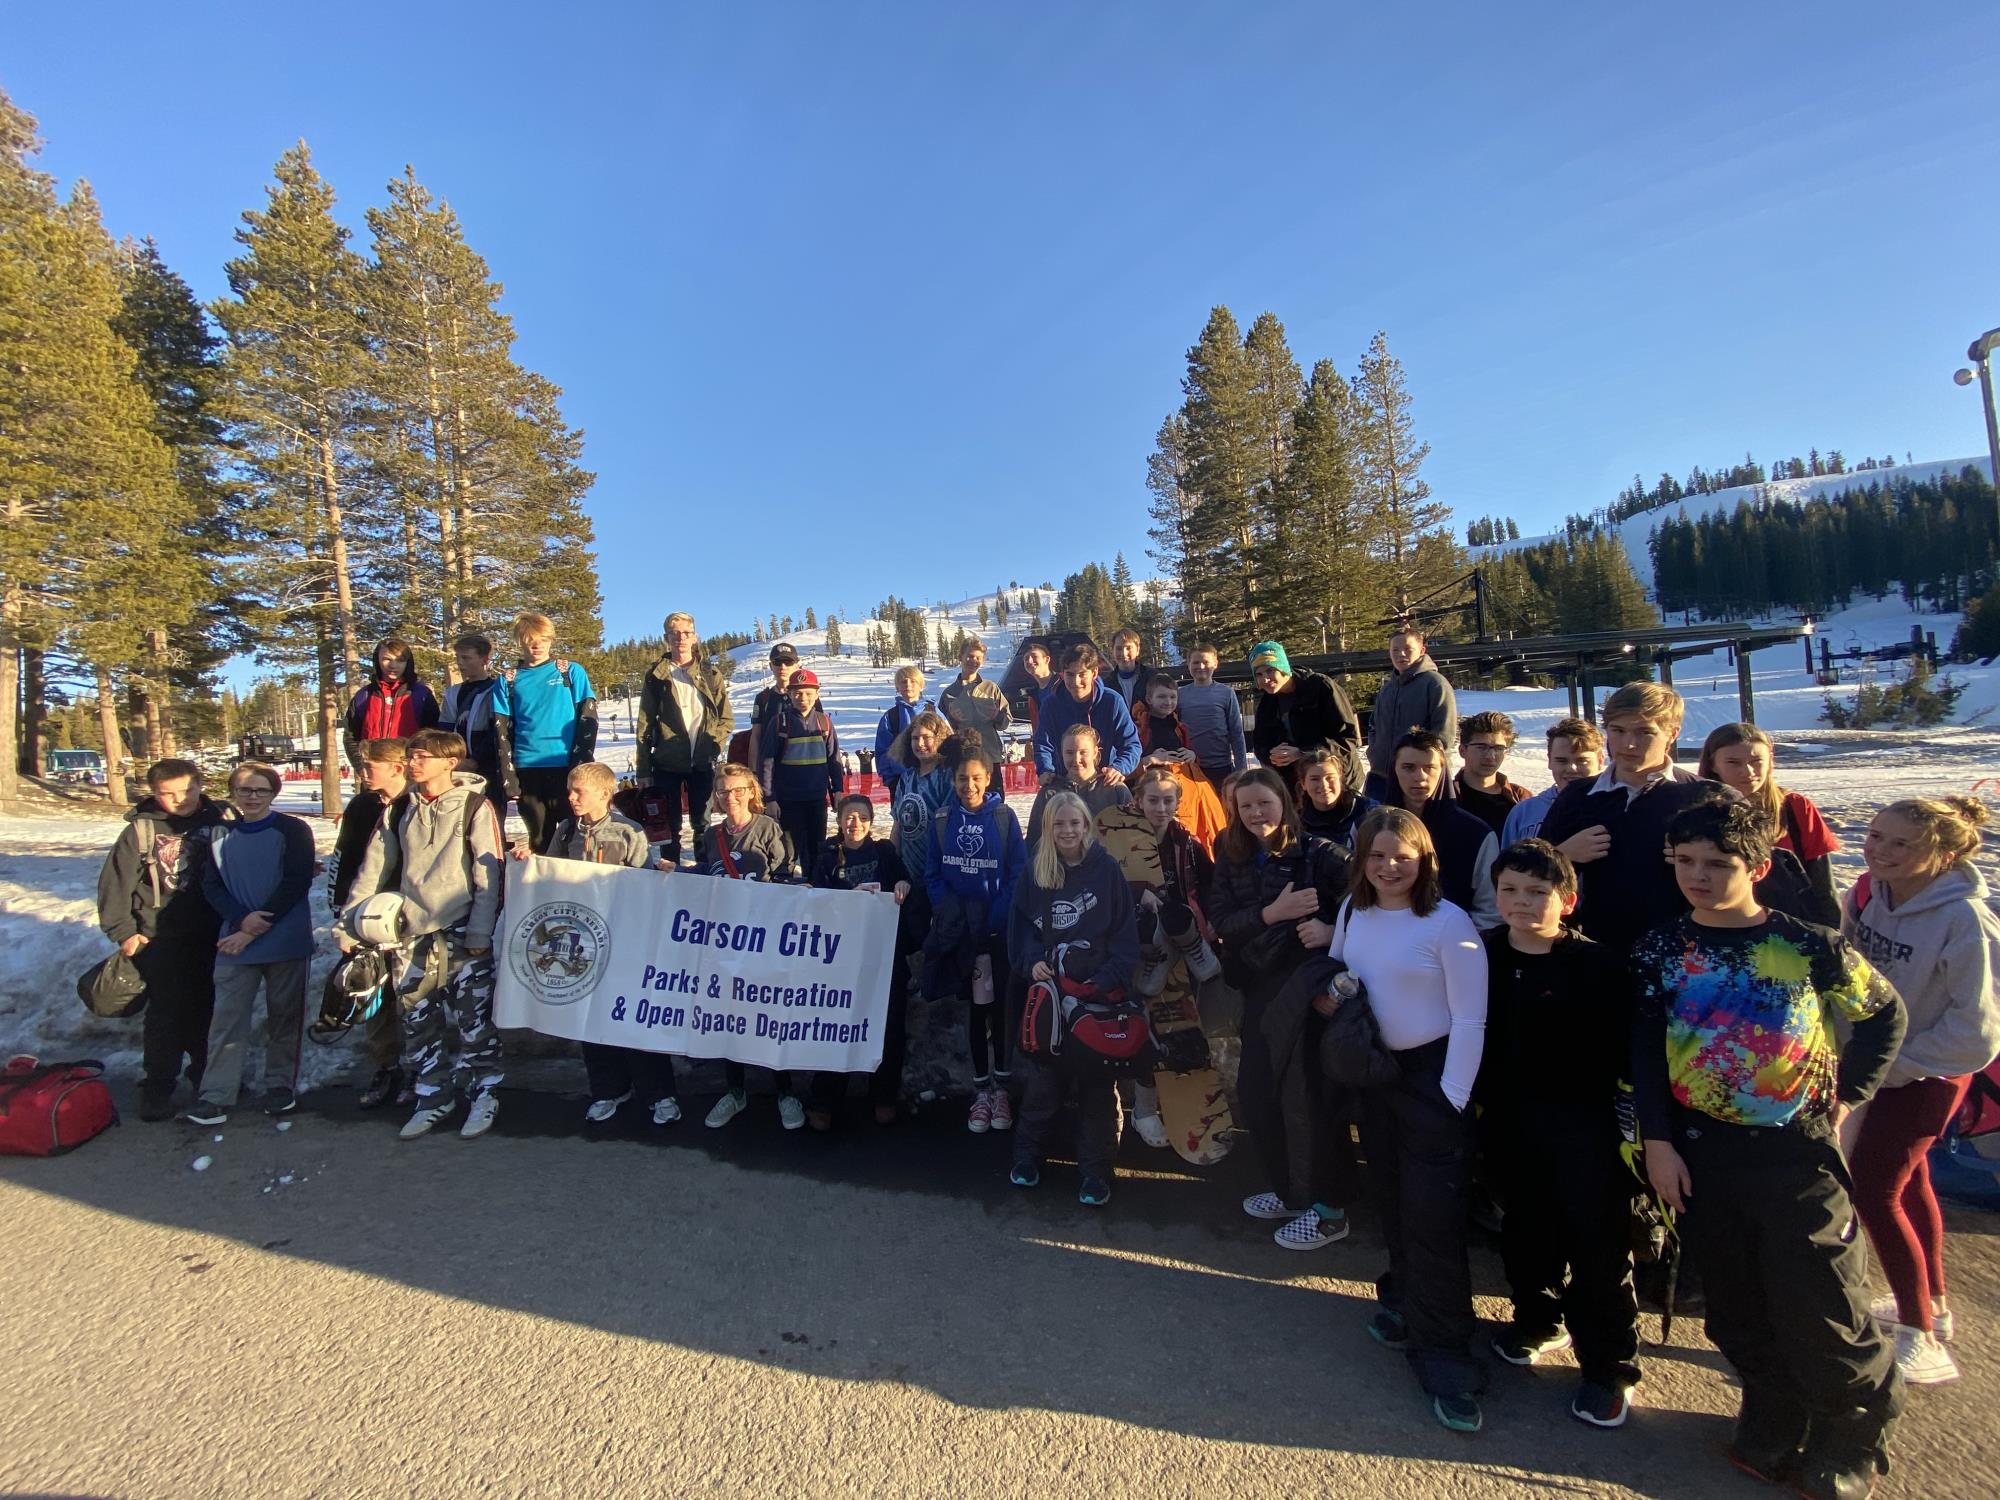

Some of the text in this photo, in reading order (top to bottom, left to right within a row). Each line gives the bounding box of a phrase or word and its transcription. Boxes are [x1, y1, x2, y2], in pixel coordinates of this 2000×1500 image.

[958, 824, 984, 834] CMS
[960, 866, 979, 874] 2020
[970, 858, 998, 869] STRONG
[521, 910, 549, 939] CARSON
[583, 916, 606, 949] NEVADA
[671, 909, 842, 965] Carson City
[642, 965, 853, 1009] Parks & Recreation
[611, 995, 869, 1046] & Open Space Department
